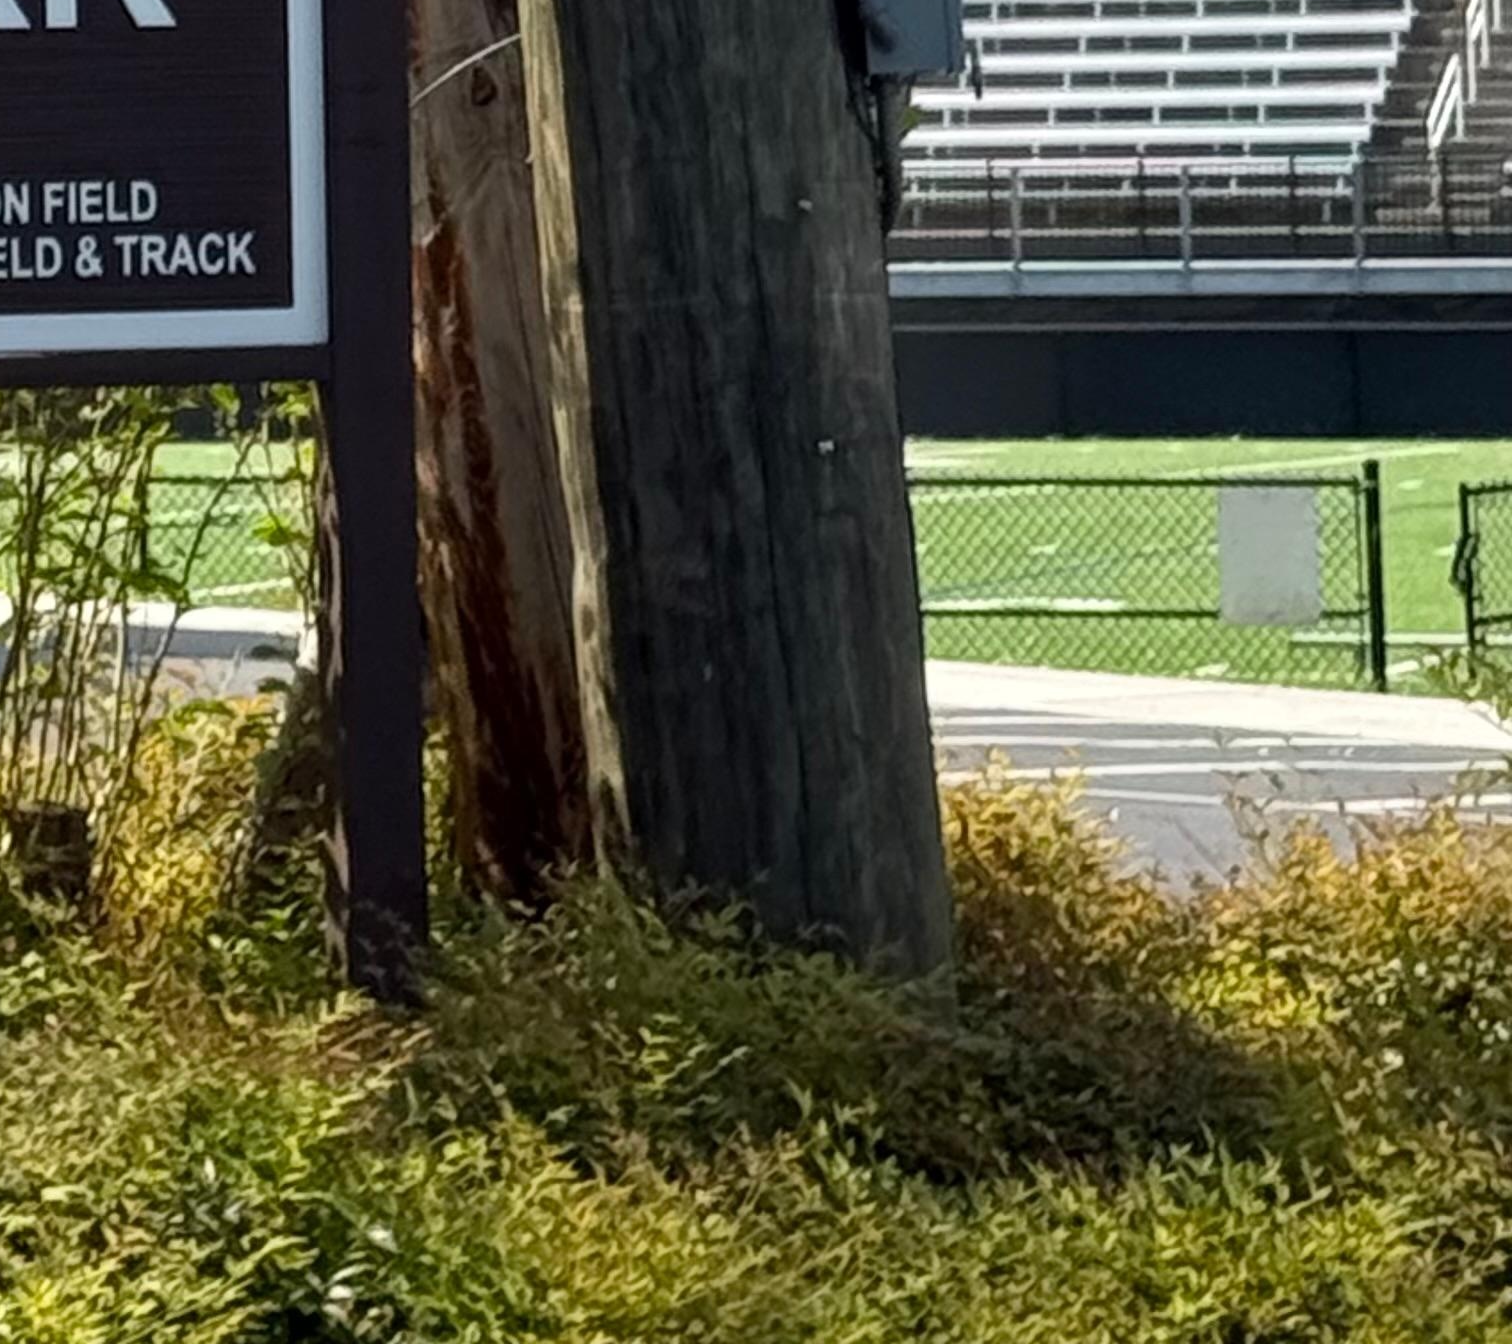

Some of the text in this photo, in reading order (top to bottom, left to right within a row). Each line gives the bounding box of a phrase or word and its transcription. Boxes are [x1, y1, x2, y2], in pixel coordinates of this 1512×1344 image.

[43, 180, 157, 223] FIELD
[75, 235, 103, 277] &
[114, 232, 256, 276] TRACK
